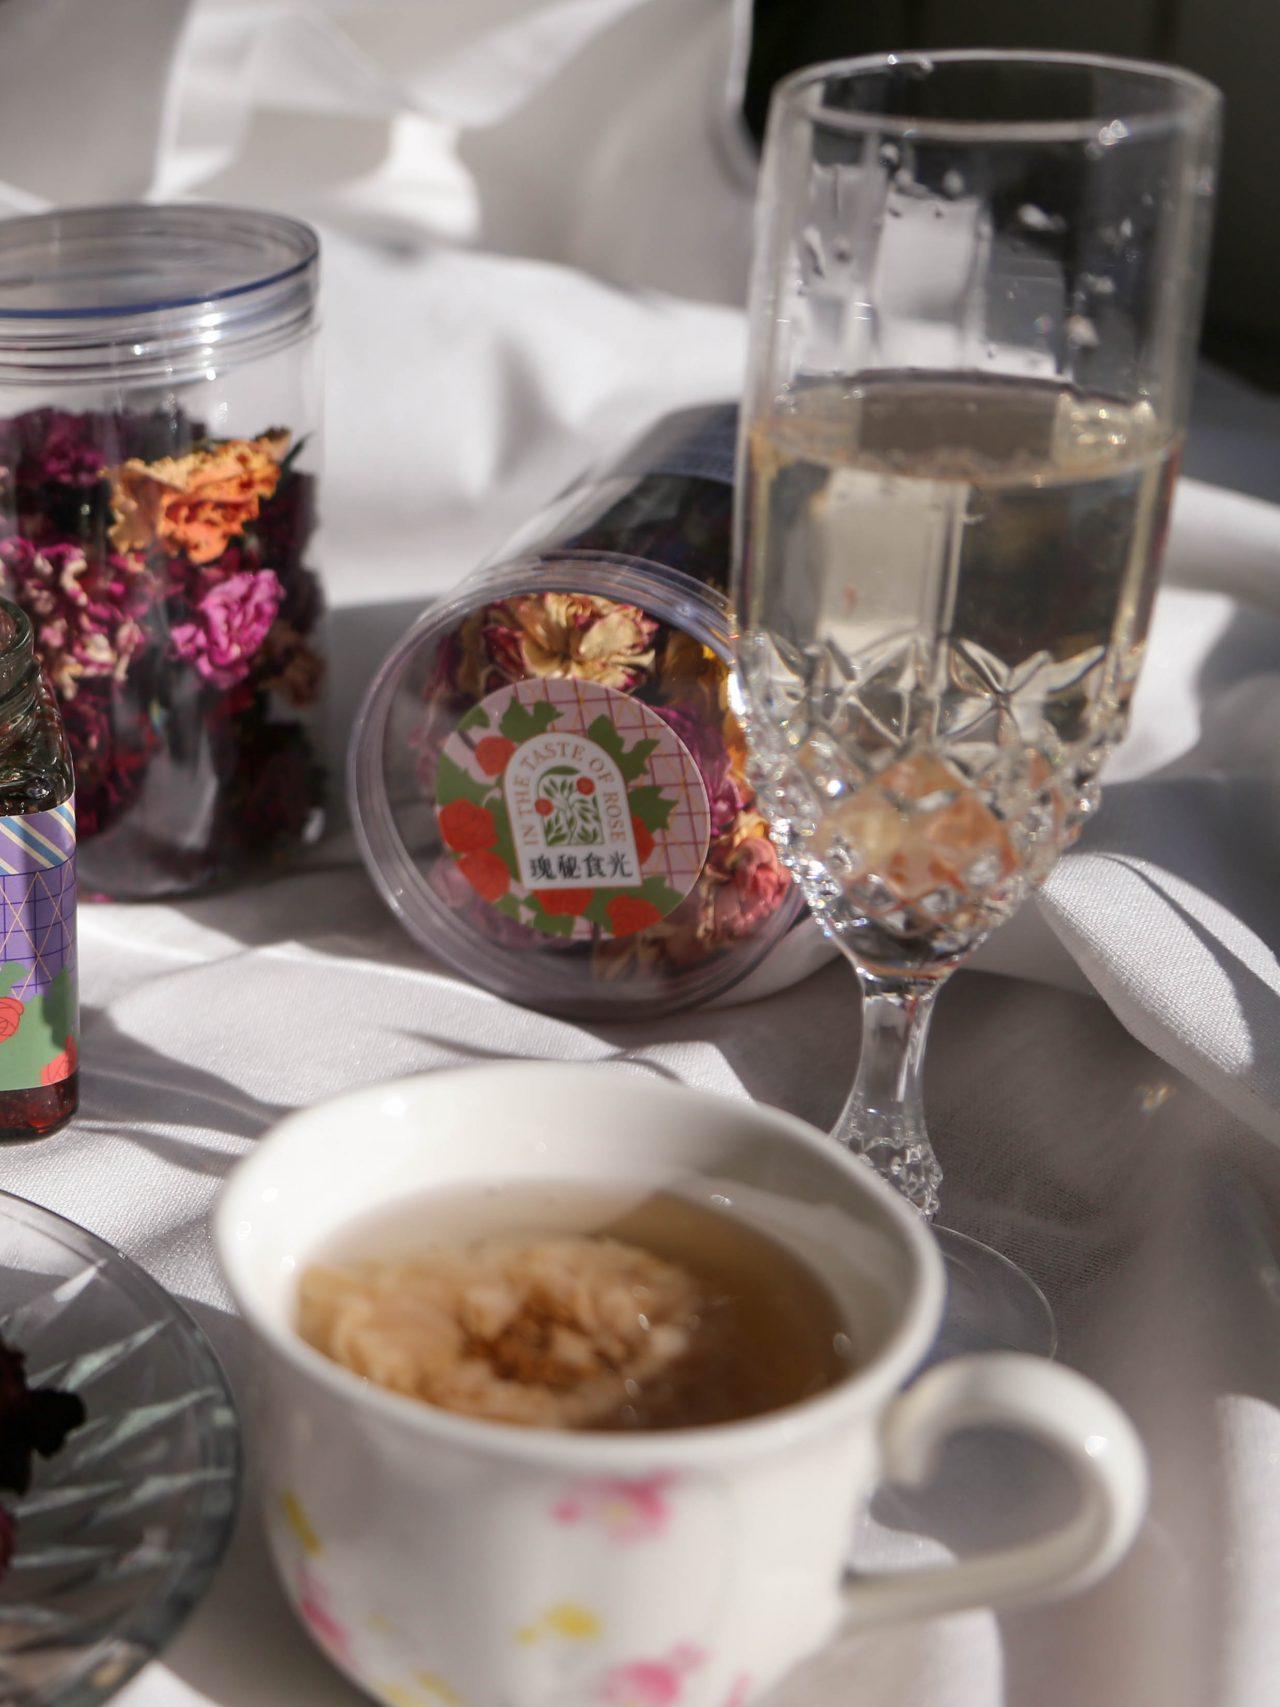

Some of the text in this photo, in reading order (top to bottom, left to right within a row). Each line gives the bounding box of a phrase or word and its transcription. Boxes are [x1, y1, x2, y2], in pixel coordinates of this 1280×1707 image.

[513, 741, 626, 845] IN THE TASTE OF ROSE
